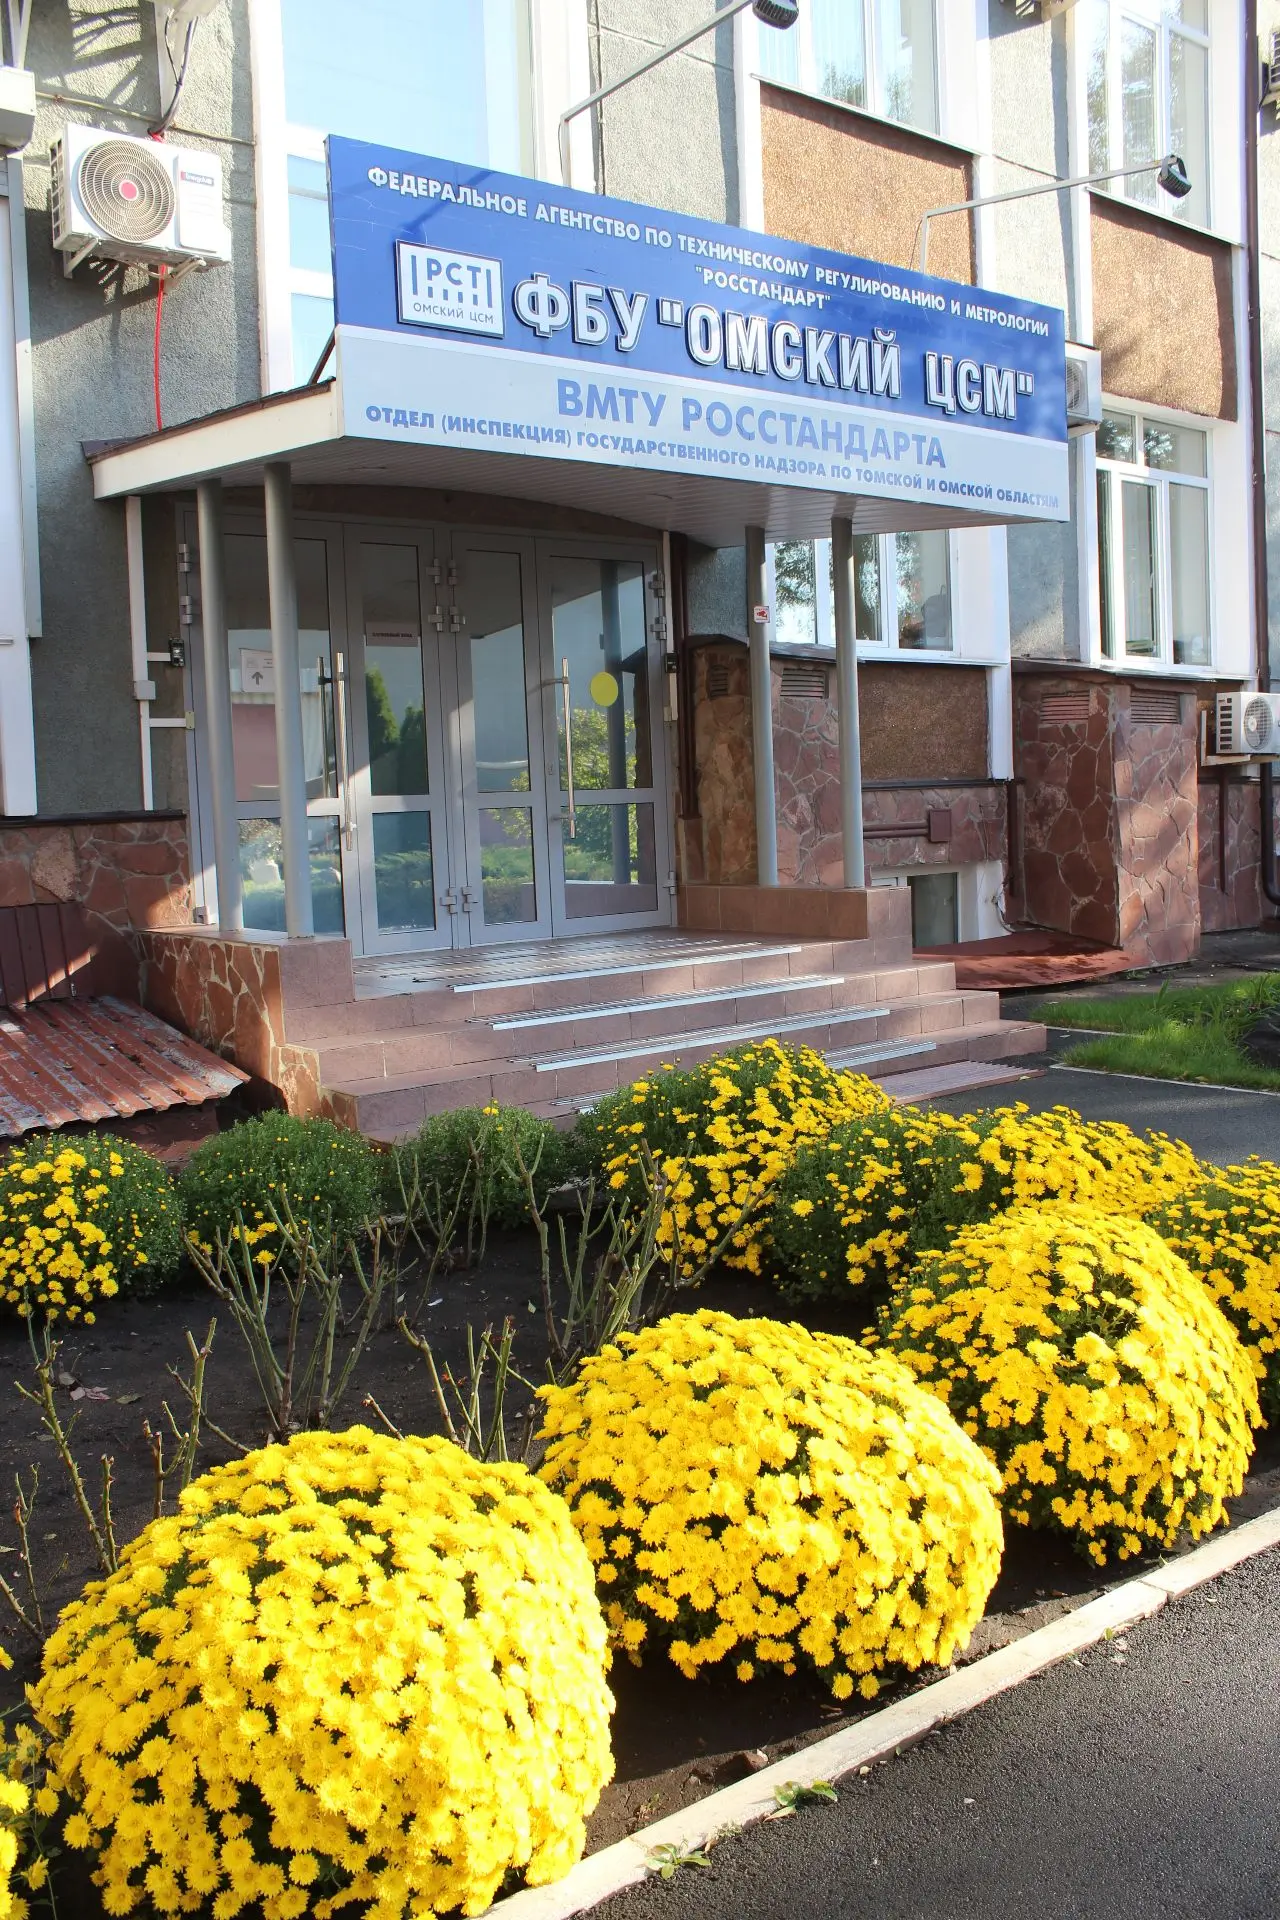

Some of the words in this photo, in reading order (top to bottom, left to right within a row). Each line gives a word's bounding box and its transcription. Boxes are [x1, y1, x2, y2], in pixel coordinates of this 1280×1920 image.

[367, 167, 528, 218] ФЕДЕРАЛЬНОЕ
[535, 207, 641, 241] АГЕНТСТВО
[645, 228, 672, 248] ПО
[677, 233, 809, 279] ТЕХНИЧЕСКОМУ
[815, 267, 946, 312] РЕГУЛИРОВАНИЮ
[950, 299, 961, 316] И
[965, 304, 1049, 336] МЕТРОЛОГИИ
[695, 266, 831, 309] "РОССТАНДАРТ"
[413, 302, 464, 320] ОМСКИЙ
[469, 311, 494, 325] ЦСМ
[512, 272, 650, 352] ФБУ
[657, 296, 902, 399] "ОМСКИЙ
[924, 351, 1035, 420] ЦСМ"
[365, 405, 435, 429] ОТДЕЛ
[441, 414, 572, 448] (ИНСПЕКЦИЯ)
[577, 432, 751, 467] ГОСУДАРСТВЕННОГО
[754, 453, 827, 478] НАДЗОРА
[830, 465, 852, 480] ПО
[856, 468, 922, 490] ТОМСКОЙ
[926, 477, 936, 491] И
[938, 479, 993, 499] ОМСКОЙ
[556, 378, 667, 427] ВМТУ
[681, 397, 947, 469] РОССТАНДАРТА
